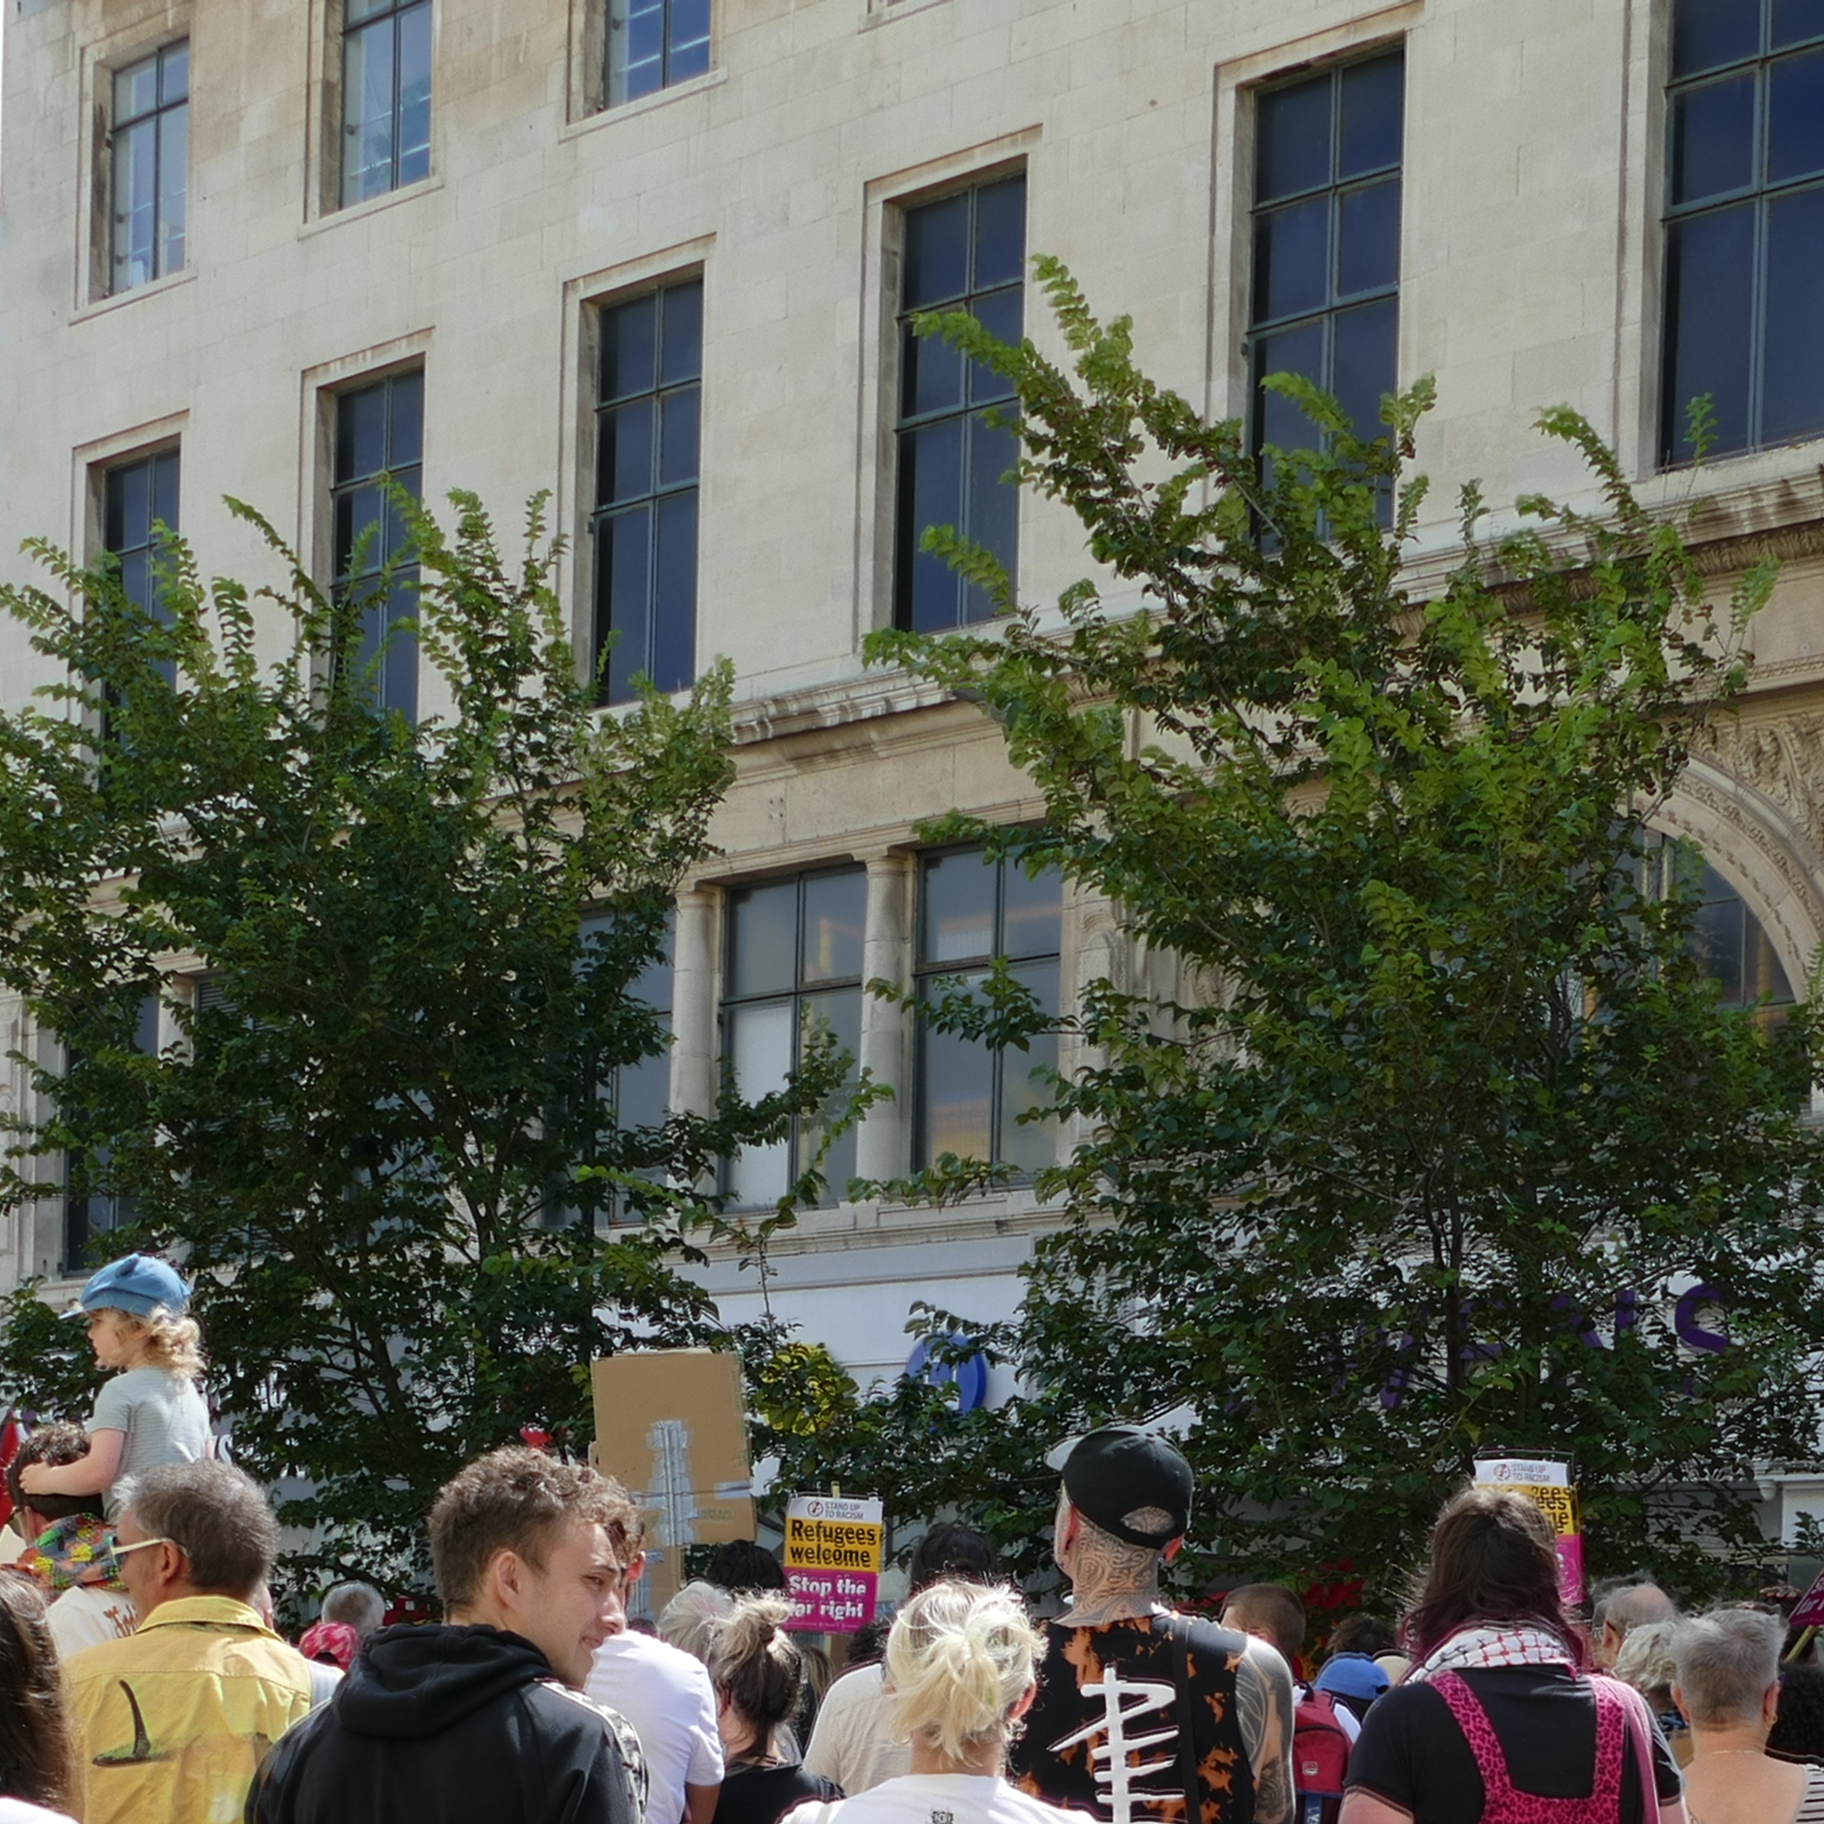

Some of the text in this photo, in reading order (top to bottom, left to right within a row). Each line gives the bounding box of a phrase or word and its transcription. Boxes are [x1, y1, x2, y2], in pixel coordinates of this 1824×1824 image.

[824, 1510, 865, 1520] TO RACISM
[825, 1502, 862, 1512] STAND UP
[791, 1519, 877, 1546] Refugees
[789, 1543, 872, 1566] welcome
[787, 1573, 867, 1597] Stop the
[819, 1598, 864, 1621] right
